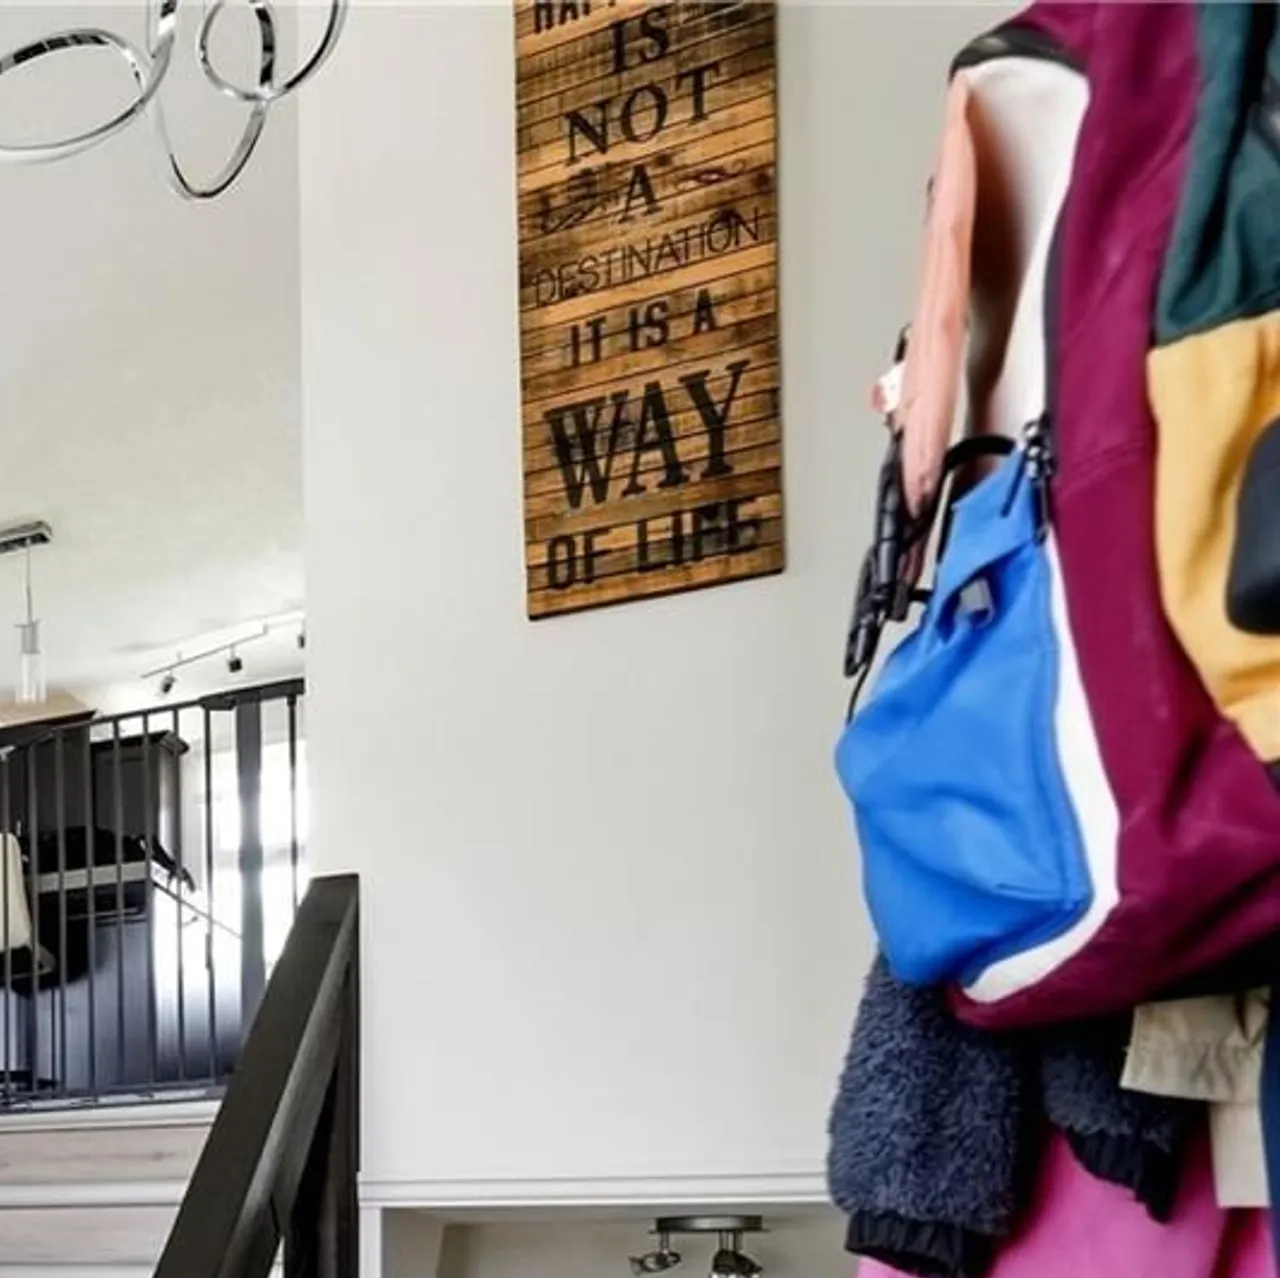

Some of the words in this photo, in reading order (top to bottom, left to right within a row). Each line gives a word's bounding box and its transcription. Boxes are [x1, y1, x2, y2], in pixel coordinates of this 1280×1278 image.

[608, 7, 670, 73] IS
[562, 62, 722, 167] NOT
[618, 164, 662, 225] A
[532, 207, 761, 306] DESTINATION
[570, 315, 607, 368] IT
[628, 300, 670, 352] IS
[693, 288, 717, 336] A
[543, 358, 751, 511] WAY
[547, 528, 614, 590] OF
[636, 496, 763, 573] LIFE
